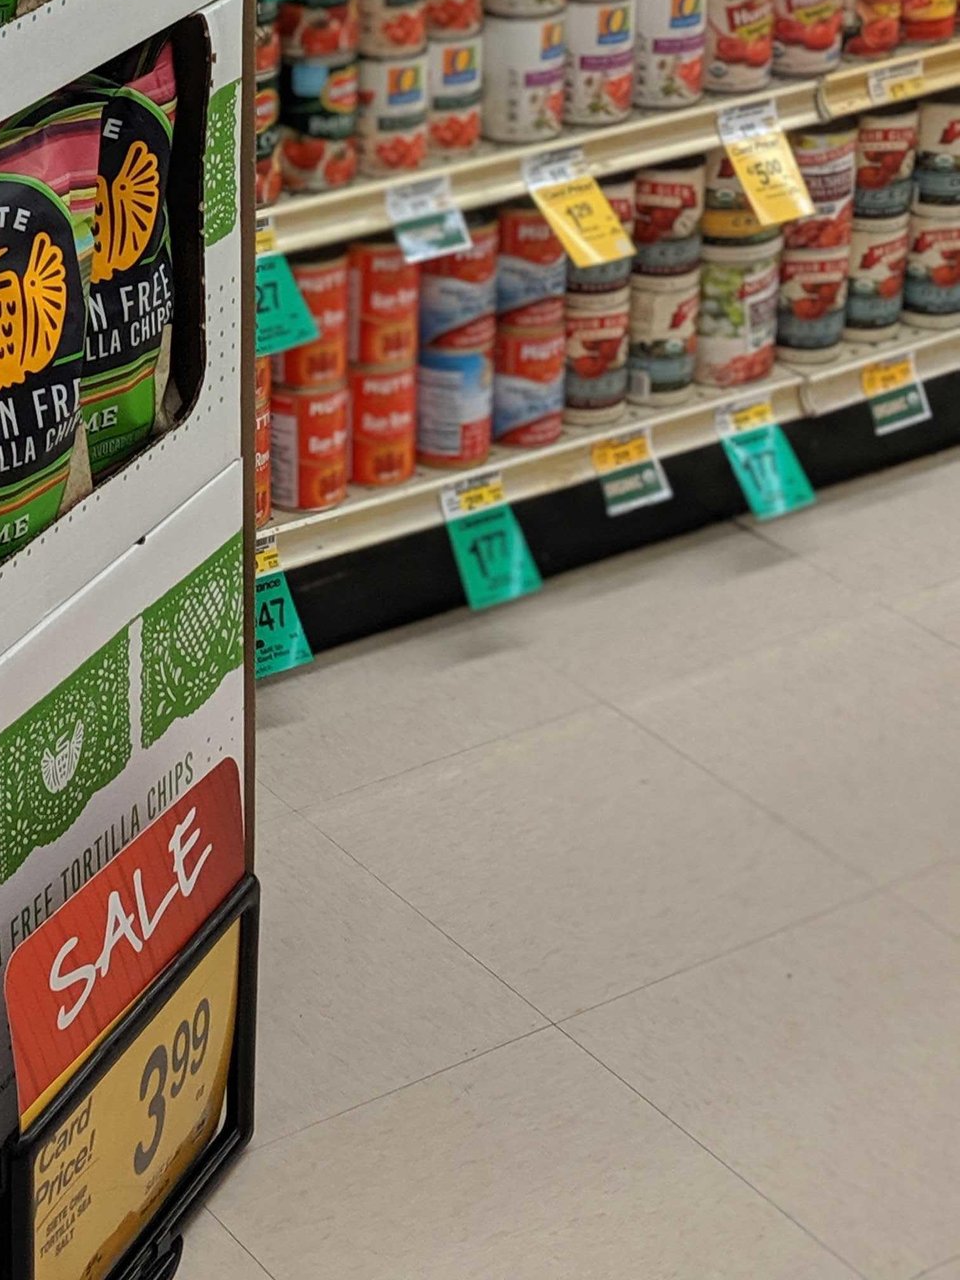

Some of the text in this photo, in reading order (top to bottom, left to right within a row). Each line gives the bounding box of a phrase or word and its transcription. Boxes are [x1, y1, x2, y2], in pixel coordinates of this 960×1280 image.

[120, 265, 173, 321] FREE
[256, 281, 280, 314] 27
[130, 299, 173, 347] CHIPS
[86, 405, 119, 433] ME
[257, 596, 286, 632] 47
[10, 883, 54, 948] FREE
[59, 803, 141, 901] TORTILLA
[146, 751, 195, 821] CHIPS
[48, 806, 214, 1030] SALE
[133, 998, 211, 1176] 399
[40, 1095, 94, 1173] Card
[35, 1128, 97, 1209] Price!
[54, 1227, 77, 1258] SALT
